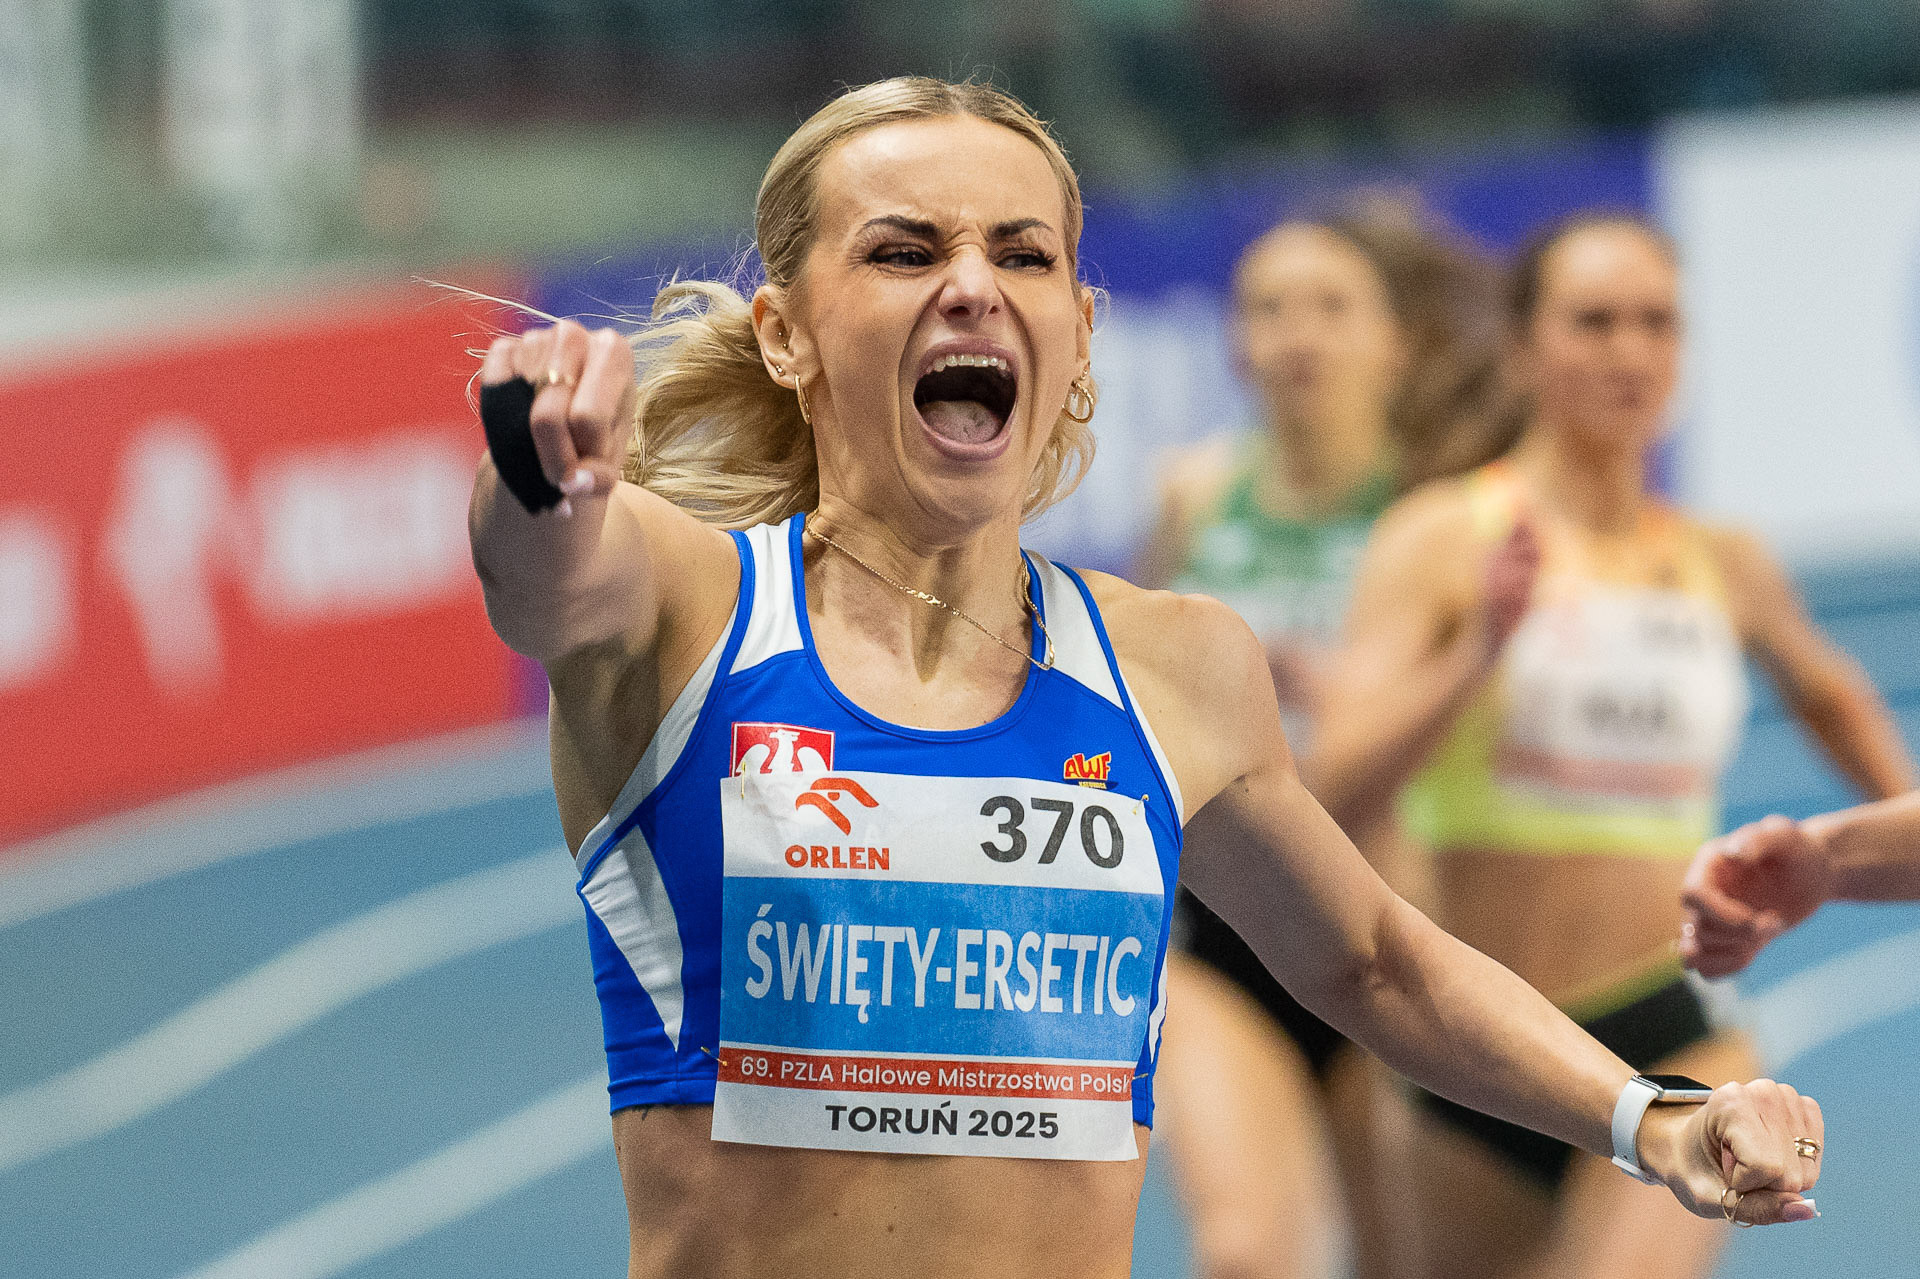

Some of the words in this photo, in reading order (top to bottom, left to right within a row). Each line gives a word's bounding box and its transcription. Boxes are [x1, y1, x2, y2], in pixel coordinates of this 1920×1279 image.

[1064, 751, 1111, 780] AWF
[980, 796, 1124, 869] 370
[785, 844, 890, 870] ORLEN
[745, 904, 1143, 1024] ŚWIĘTY-ERSETIC
[741, 1055, 774, 1079] 69.
[780, 1060, 835, 1083] PZLA
[841, 1063, 931, 1086] Halowe
[938, 1066, 1074, 1092] Mistrzostwa
[1080, 1073, 1132, 1093] Polsk
[825, 1100, 959, 1135] TORUŃ
[968, 1109, 1059, 1139] 2025
